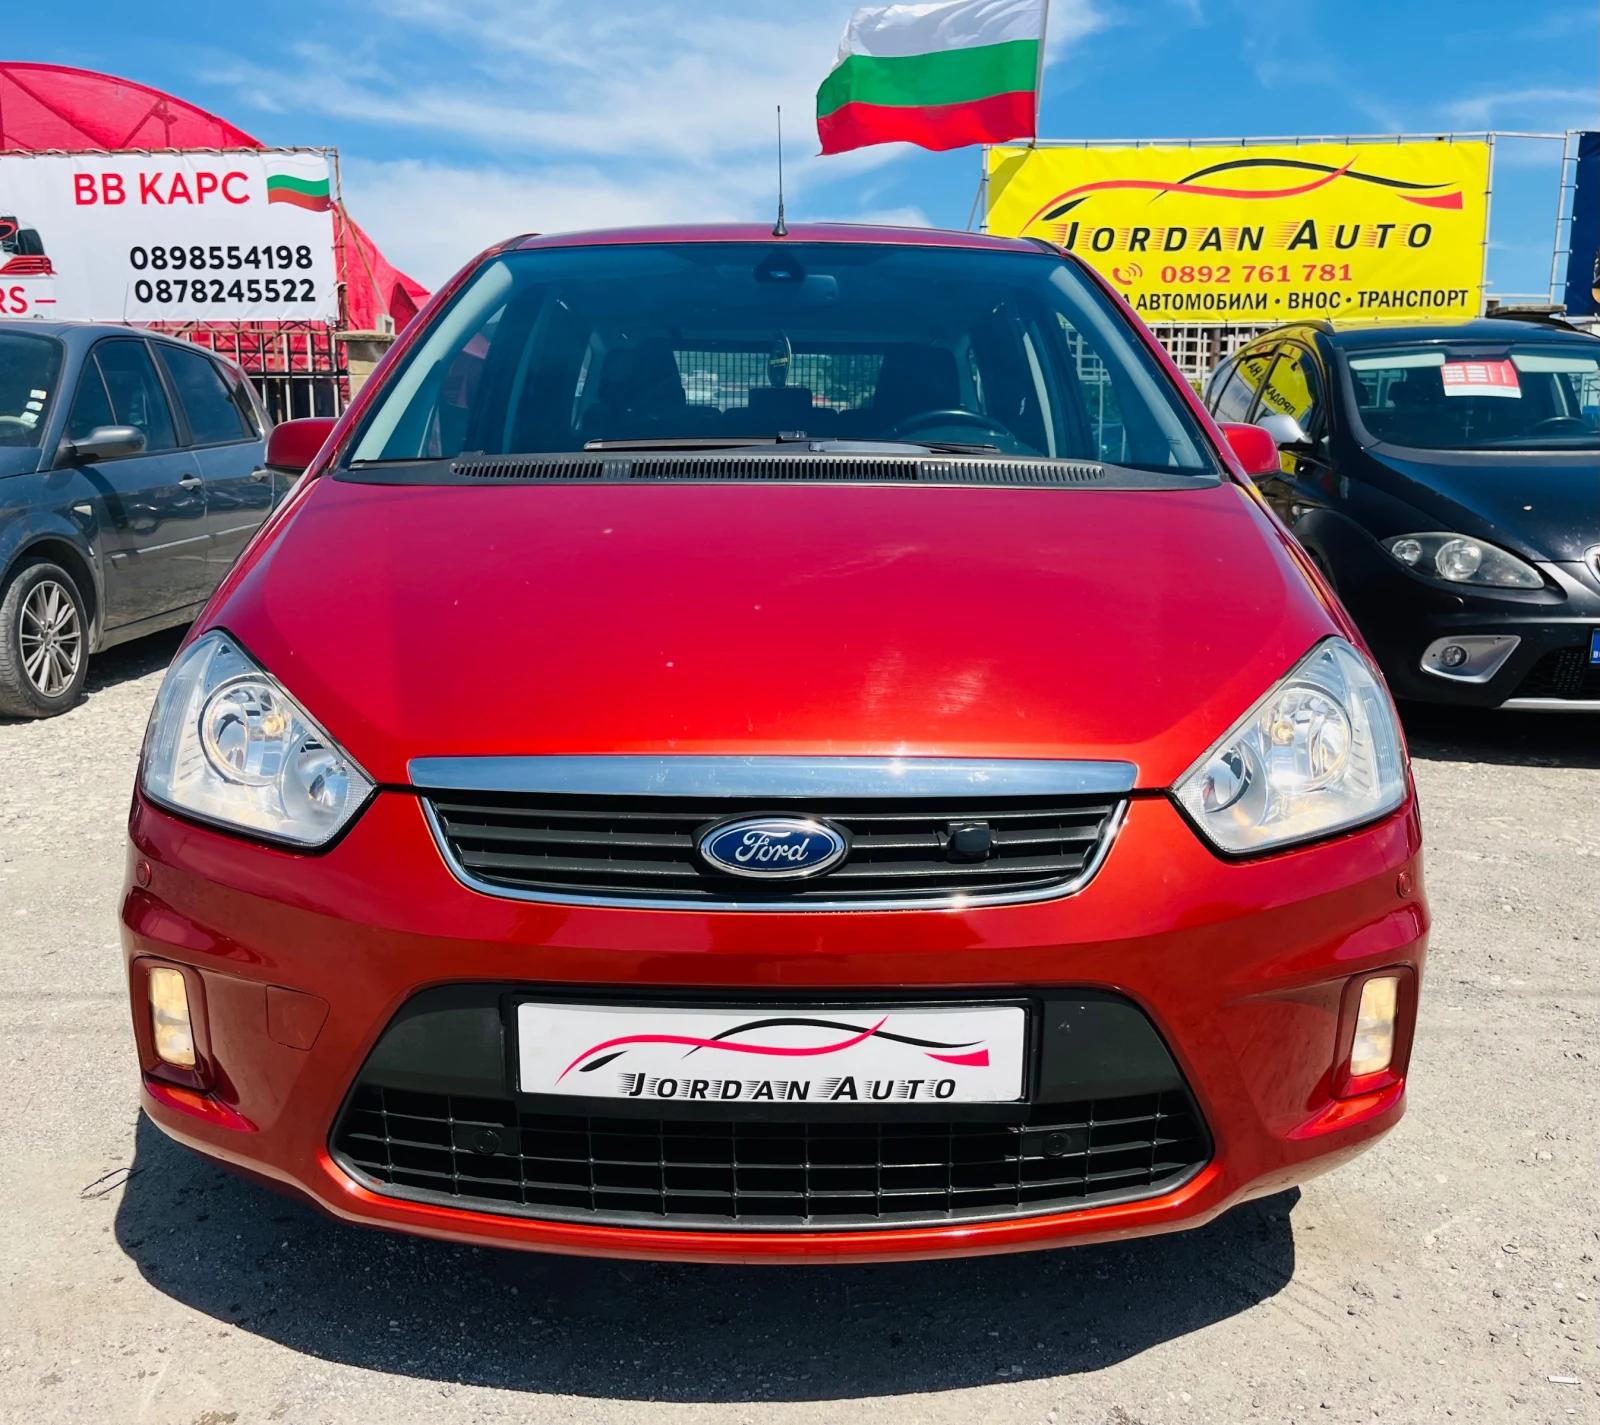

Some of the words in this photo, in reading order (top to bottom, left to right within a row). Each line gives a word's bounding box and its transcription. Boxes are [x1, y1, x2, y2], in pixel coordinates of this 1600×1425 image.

[73, 173, 126, 206] ВВ
[139, 171, 251, 205] КАРС
[1062, 221, 1265, 252] JORDAN
[1286, 219, 1432, 251] AUTO
[130, 245, 313, 270] 0898554198
[1160, 265, 1231, 284] 0892
[1241, 264, 1291, 283] 761
[1302, 263, 1353, 282] 781
[135, 279, 316, 303] 0878245522
[1136, 293, 1268, 311] АВТОМОБИЛИ
[1288, 291, 1342, 310] ВНОС
[1357, 290, 1469, 308] ТРАНСПОРТ
[735, 830, 809, 862] Ford
[627, 1072, 811, 1100] JORDAN
[830, 1076, 957, 1101] AUTO
